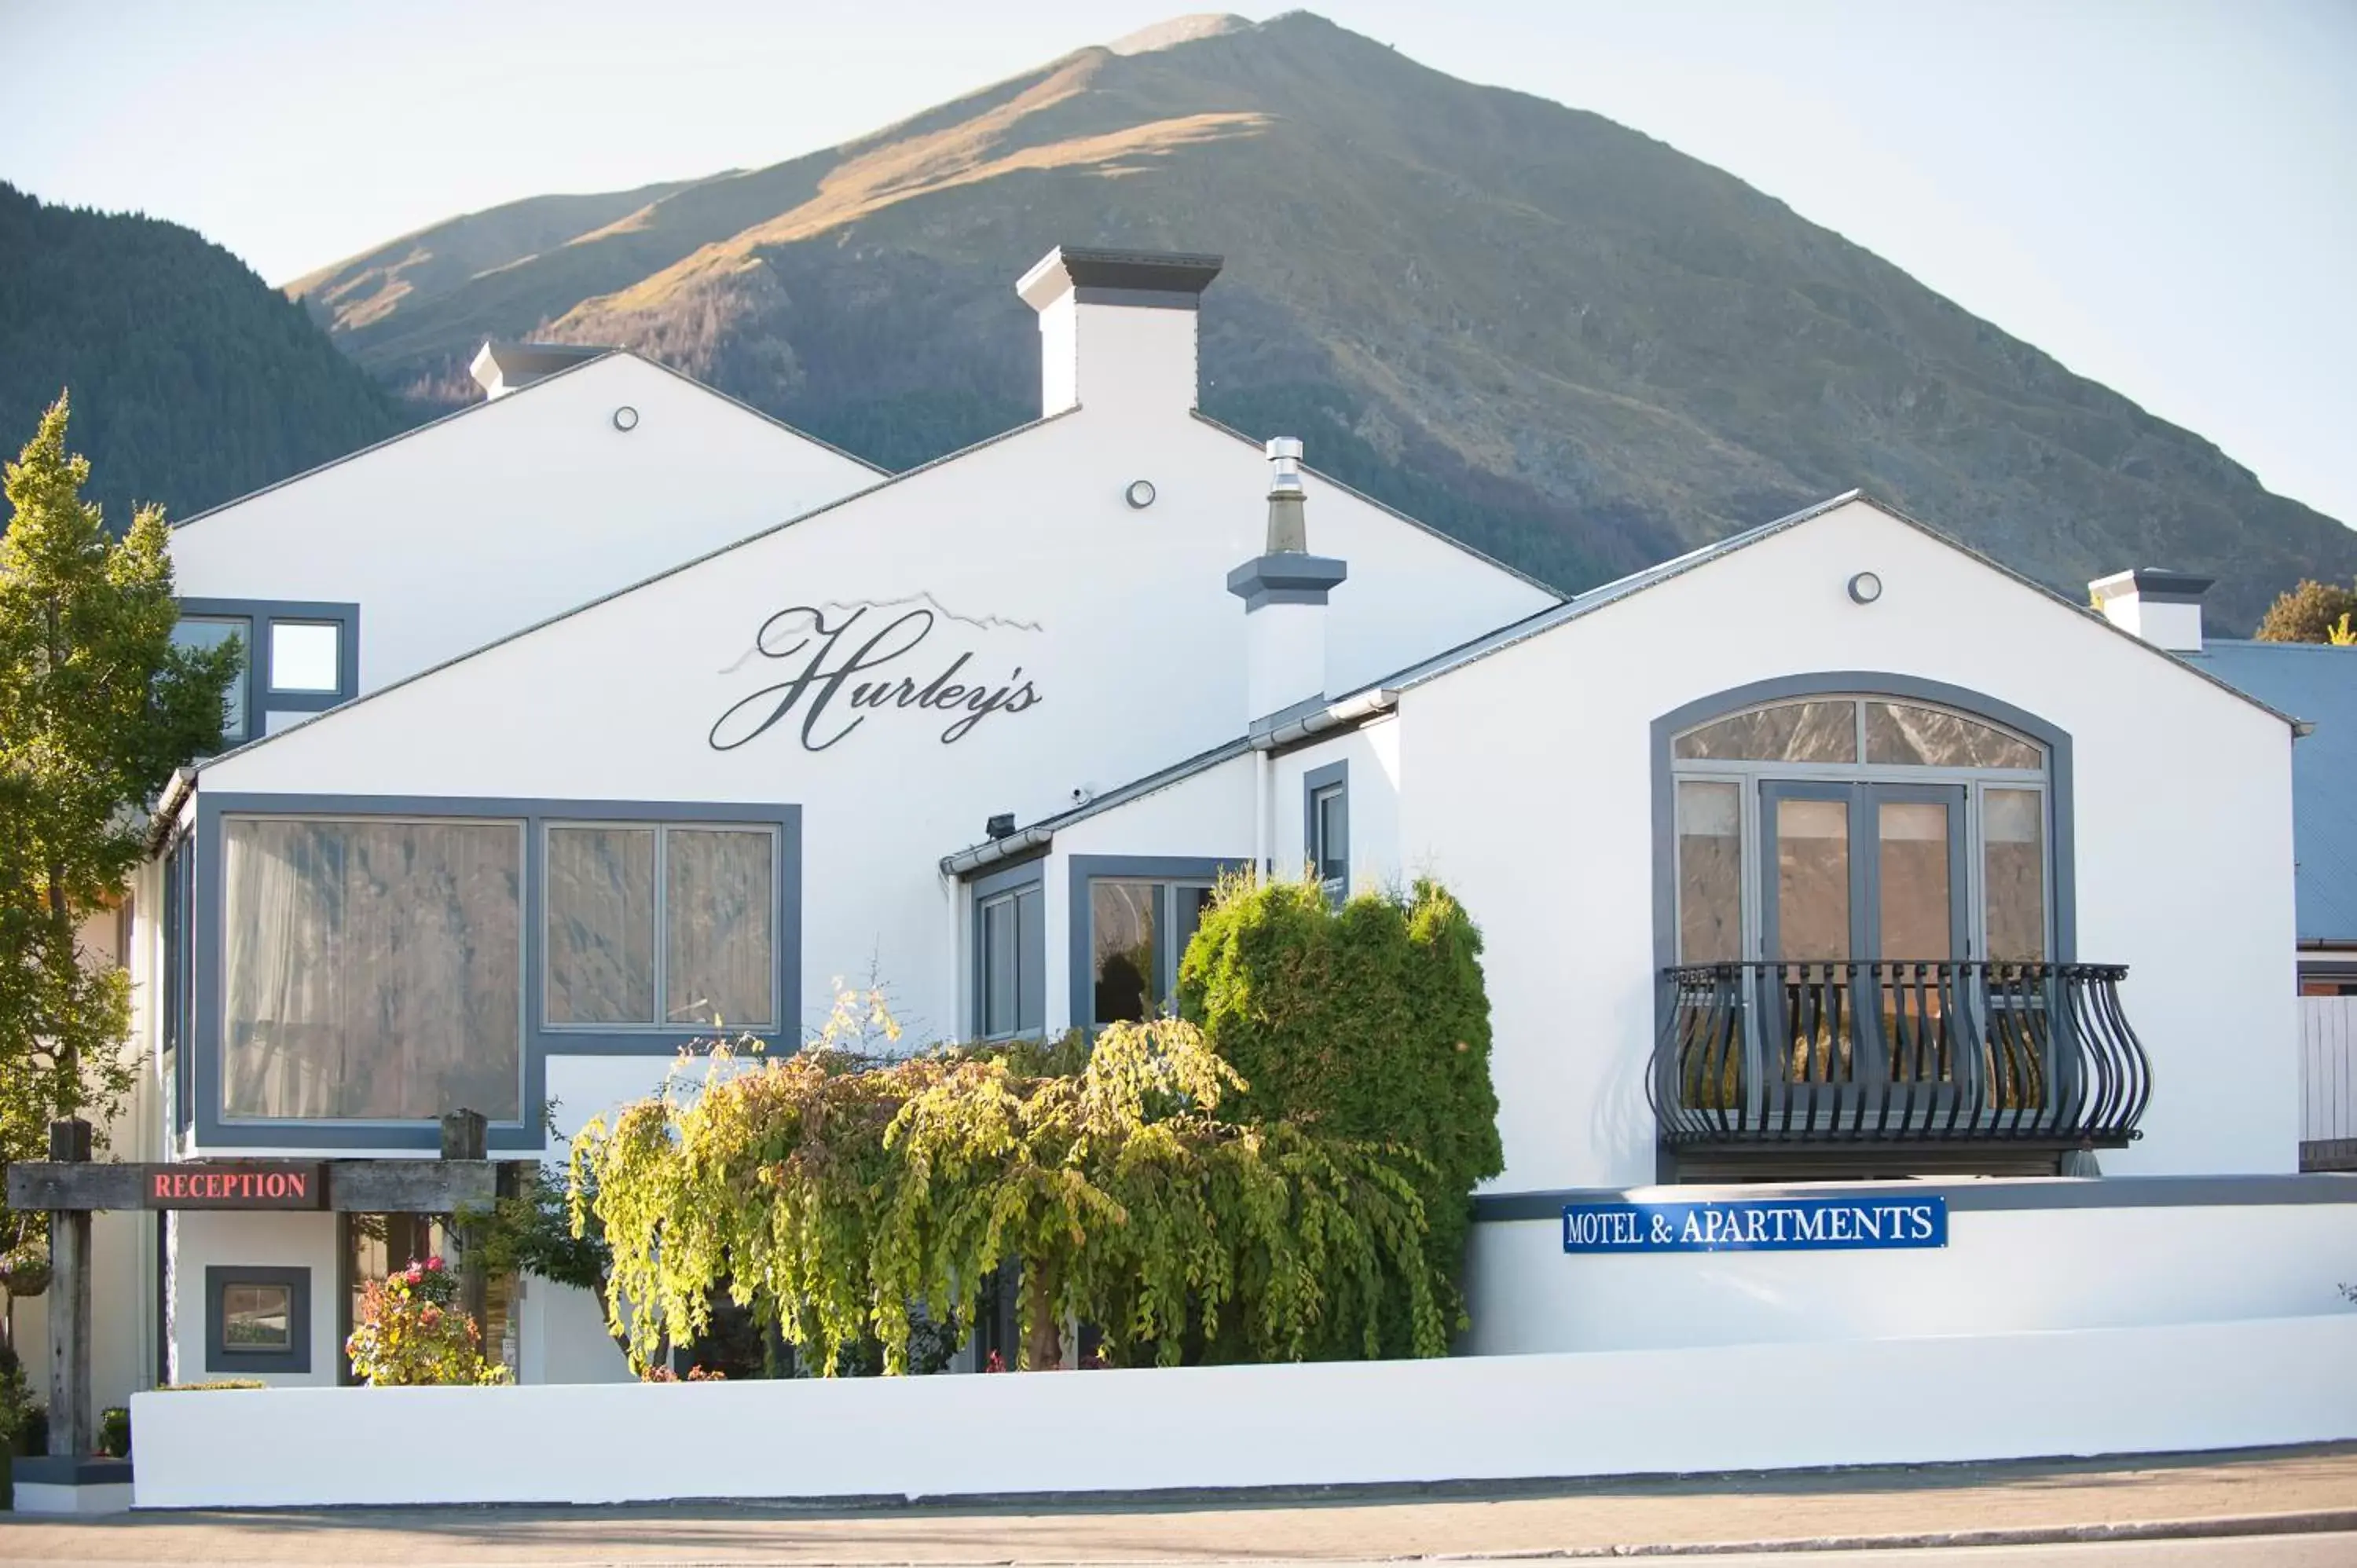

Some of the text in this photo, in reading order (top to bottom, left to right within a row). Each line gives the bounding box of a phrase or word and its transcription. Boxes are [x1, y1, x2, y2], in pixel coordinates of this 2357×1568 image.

[709, 606, 1042, 751] Hurley's
[153, 1174, 306, 1198] RECEPTION
[1567, 1207, 1933, 1244] MOTEL & APARTMENTS
